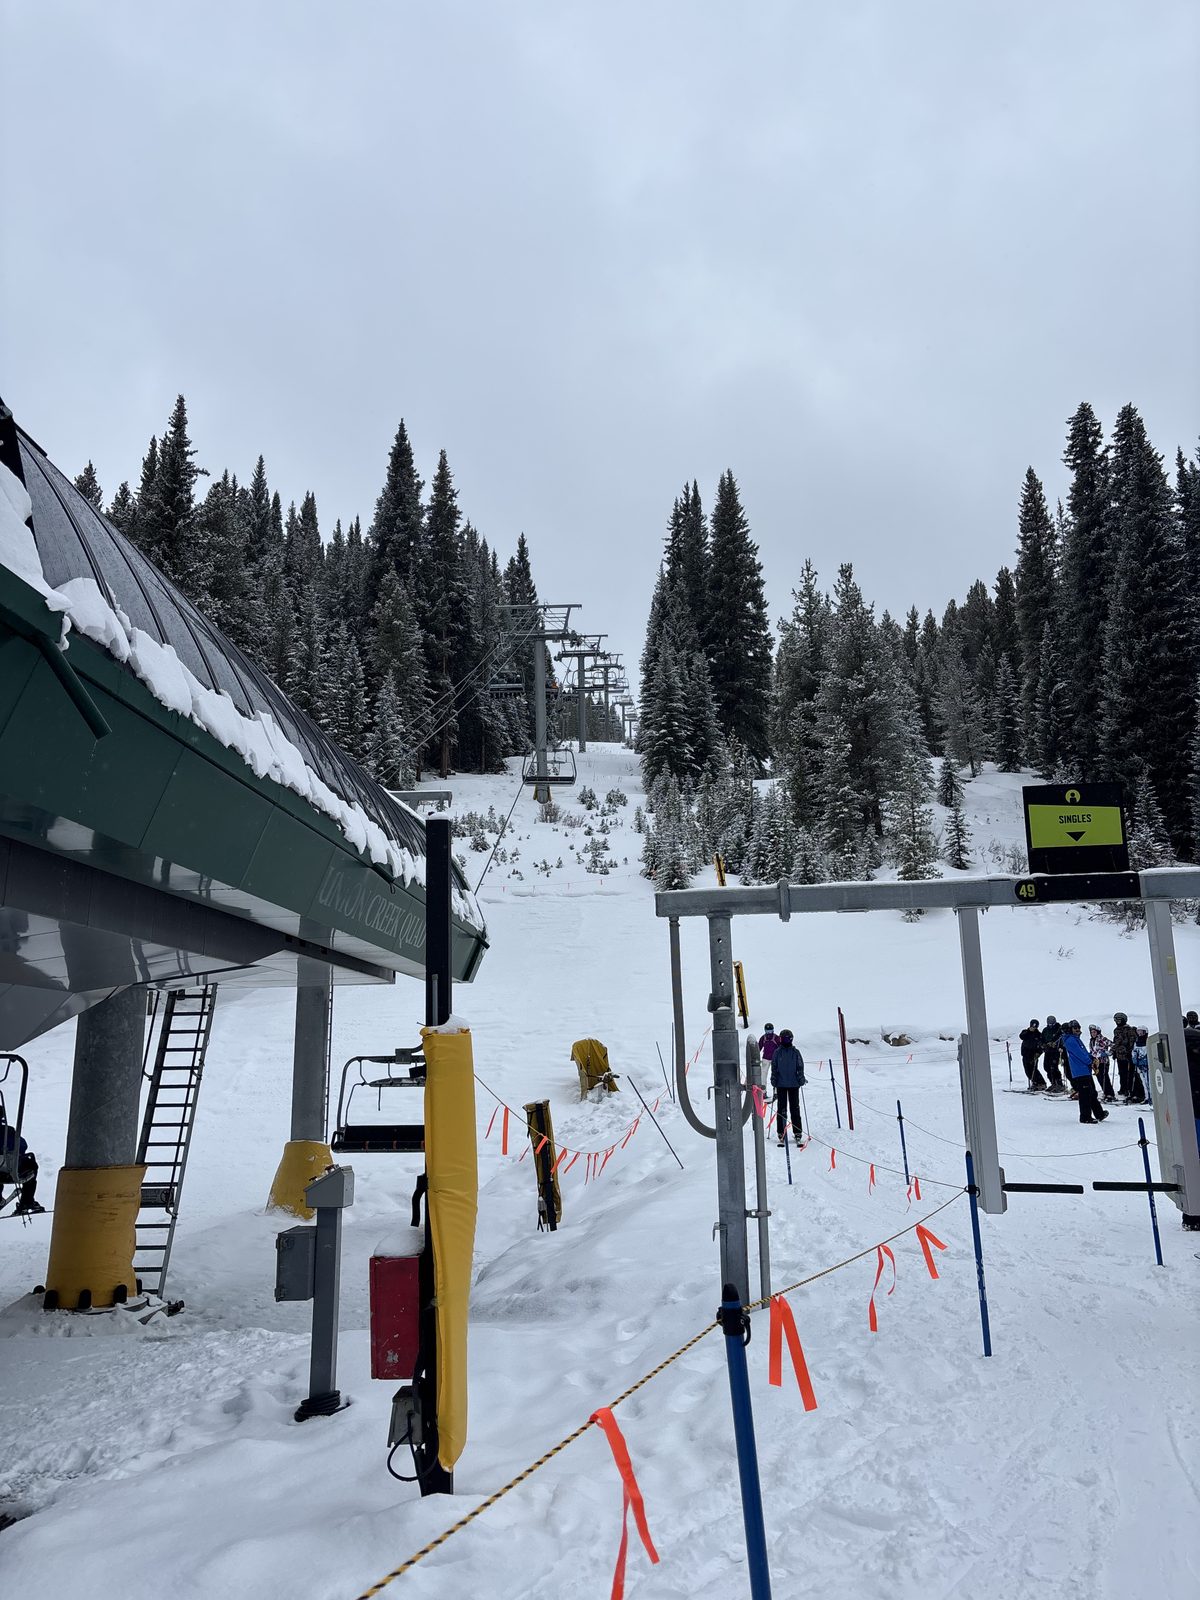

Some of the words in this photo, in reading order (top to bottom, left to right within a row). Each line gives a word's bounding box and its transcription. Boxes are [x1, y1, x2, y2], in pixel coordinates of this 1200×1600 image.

[1058, 814, 1092, 824] SINGLES
[1019, 884, 1036, 897] 49
[319, 867, 371, 921] UNION
[365, 895, 406, 938] CREEK
[399, 914, 426, 949] QUAD
